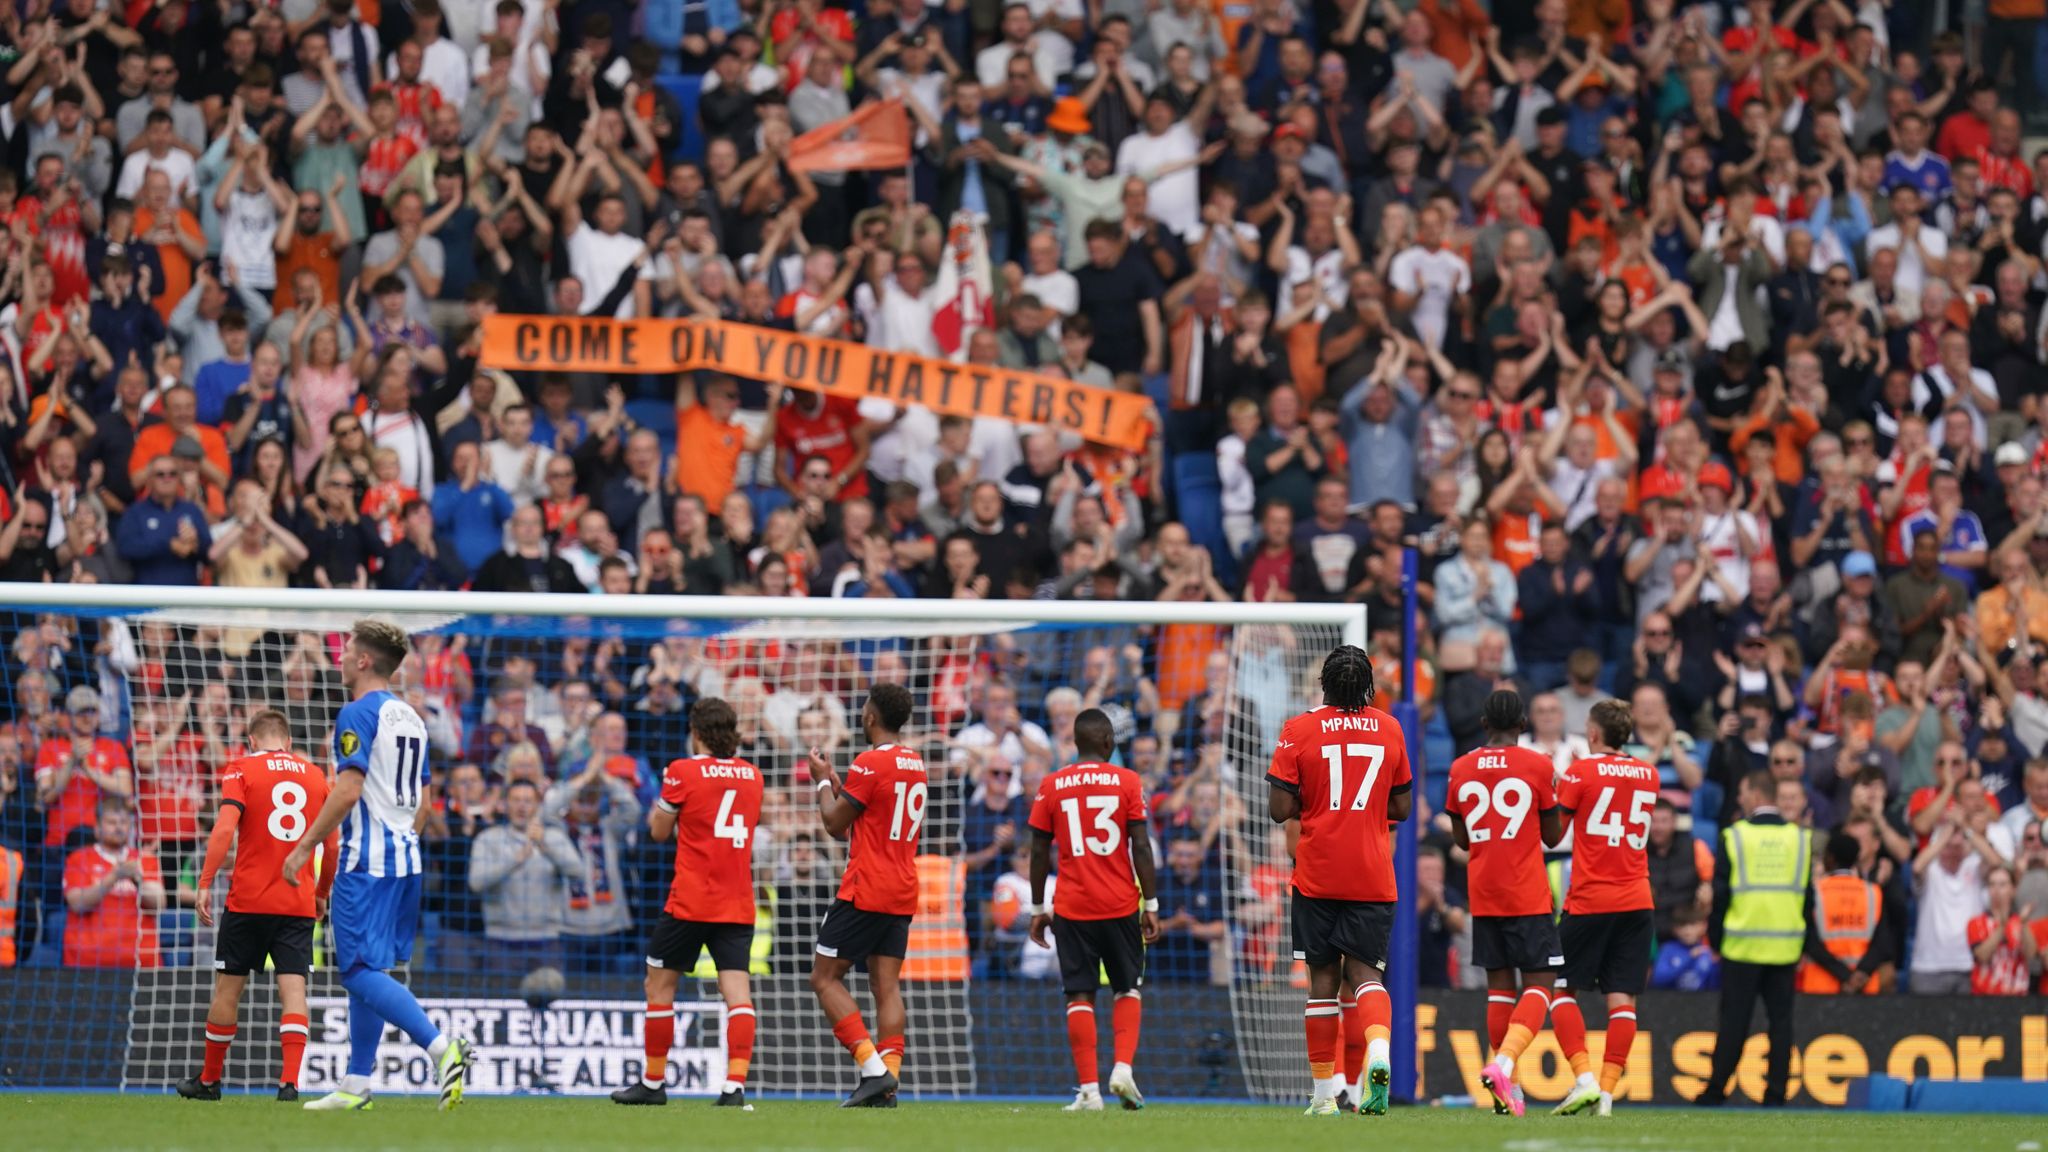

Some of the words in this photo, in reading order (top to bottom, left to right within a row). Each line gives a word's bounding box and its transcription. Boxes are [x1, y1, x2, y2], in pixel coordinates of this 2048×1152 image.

[517, 323, 638, 365] COME
[672, 326, 727, 365] ON
[755, 335, 843, 385] YOU
[868, 354, 1112, 435] HATTERS!
[1321, 717, 1379, 733] MPANZU
[266, 759, 306, 774] BERRY
[395, 736, 421, 808] 11
[701, 765, 755, 780] LOCKYER
[896, 756, 925, 772] BROWN
[1055, 773, 1120, 790] NAKAMBA
[1321, 744, 1385, 811] 17
[1477, 756, 1508, 770] BELL
[1597, 763, 1652, 781] DOUGHTY
[267, 781, 307, 842] 8
[714, 790, 748, 848] 4
[890, 782, 928, 842] 19
[1060, 795, 1121, 857] 13
[1458, 777, 1533, 843] 29
[1586, 786, 1657, 850] 45
[507, 1010, 696, 1046] EQUALIY
[490, 1057, 562, 1087] THE
[573, 1057, 708, 1088] ALBON
[1671, 1031, 1870, 1105] see
[1887, 1034, 2005, 1083] or
